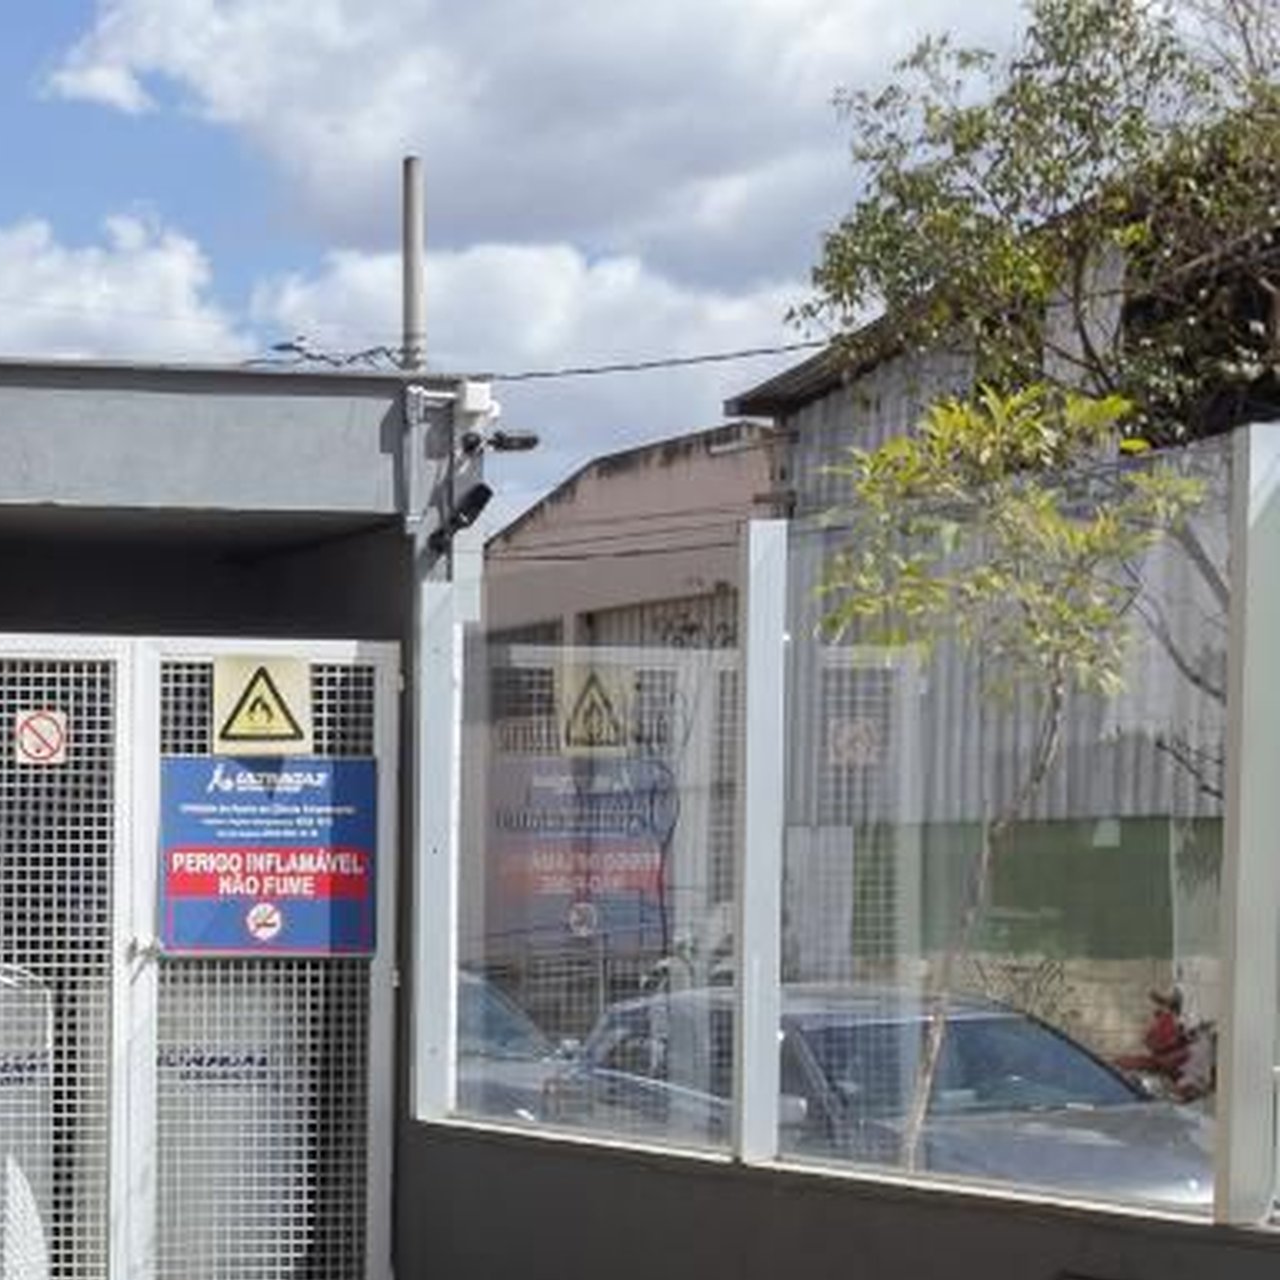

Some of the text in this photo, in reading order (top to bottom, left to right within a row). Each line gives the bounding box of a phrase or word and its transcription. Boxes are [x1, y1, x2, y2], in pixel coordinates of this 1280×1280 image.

[172, 848, 365, 874] PERIGO INFLAMÁVEL
[218, 873, 315, 895] NÃO FUME
